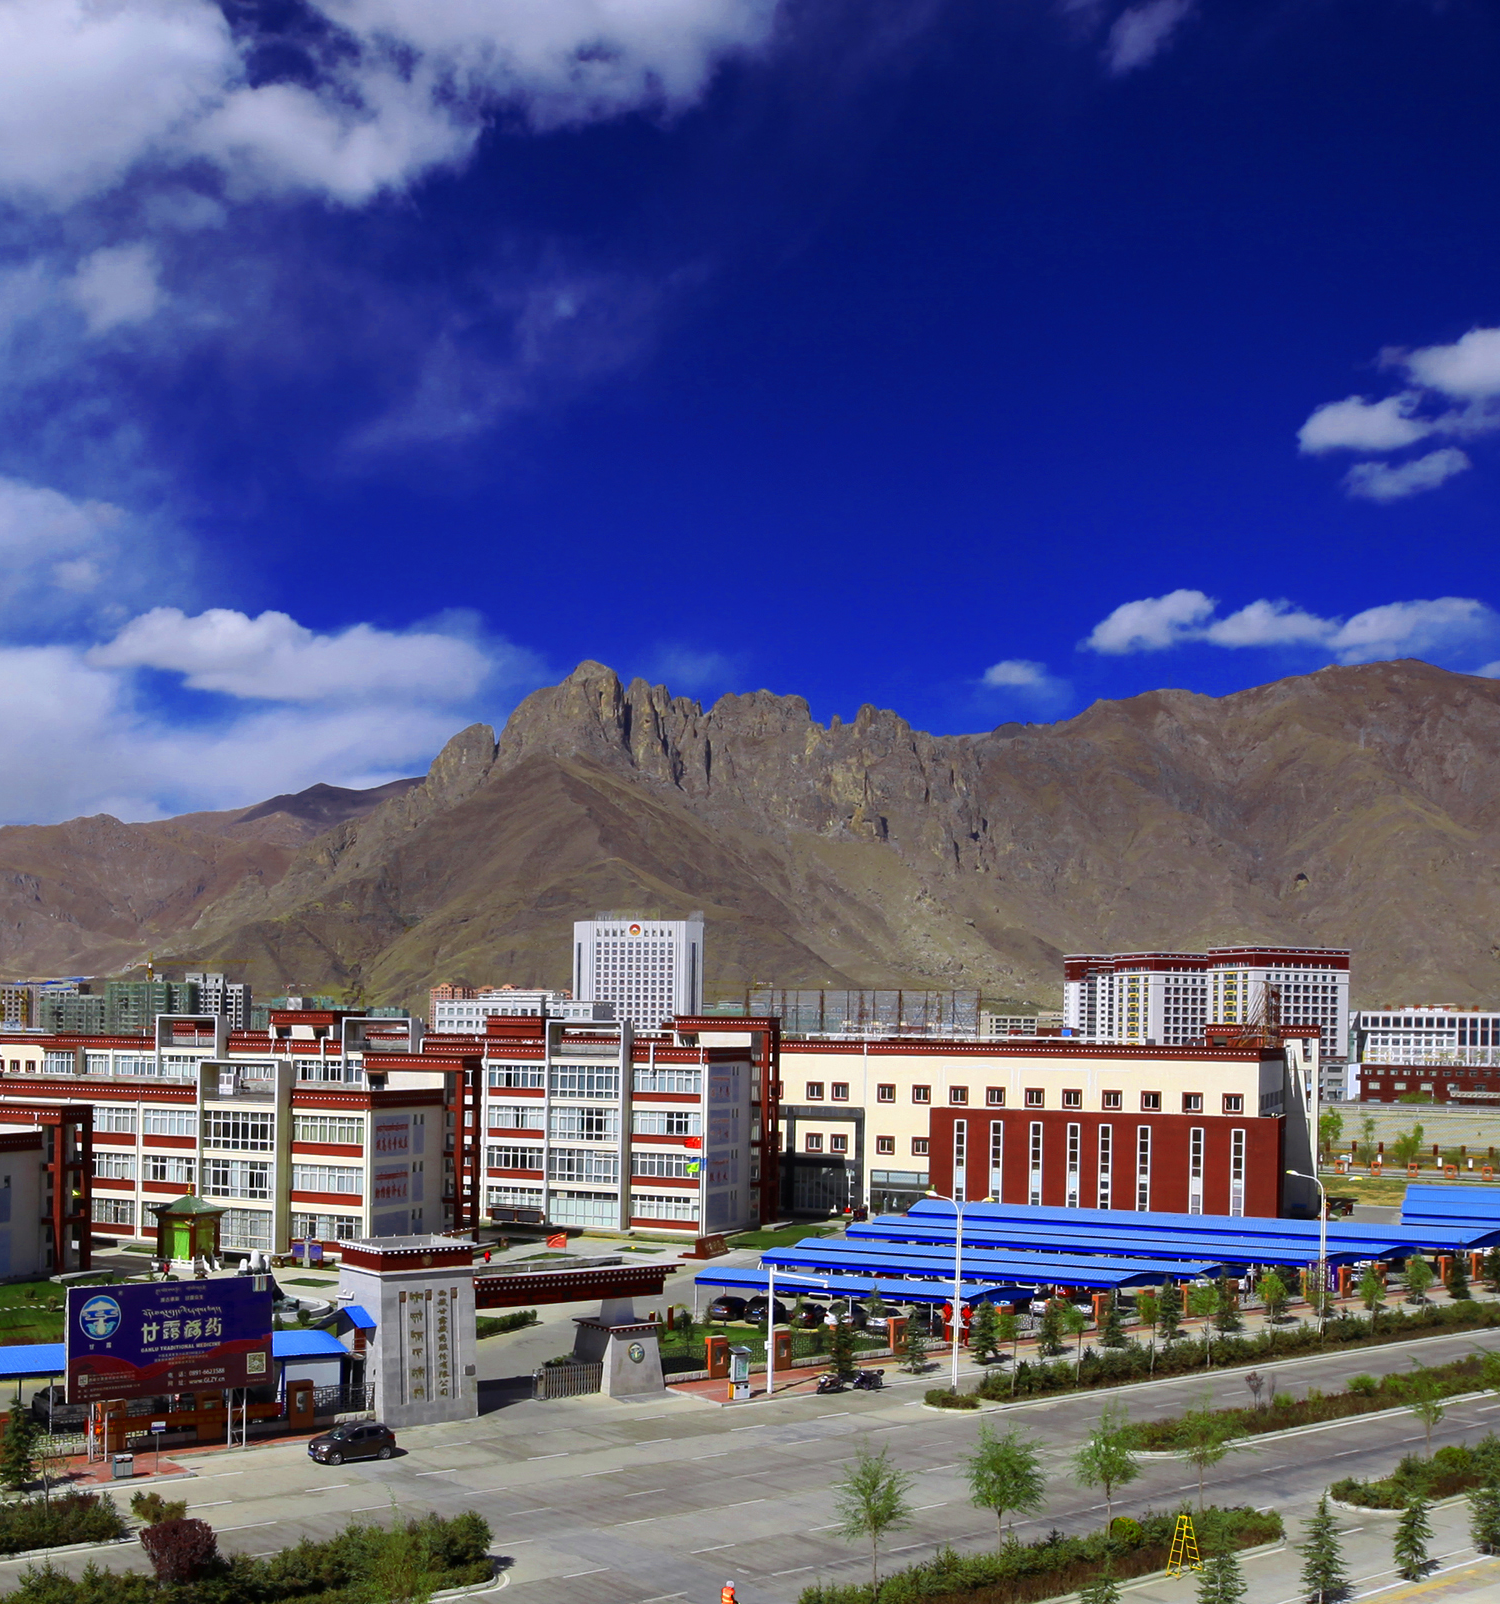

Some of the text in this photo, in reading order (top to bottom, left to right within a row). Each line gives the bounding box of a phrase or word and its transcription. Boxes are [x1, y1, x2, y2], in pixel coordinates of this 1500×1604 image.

[141, 1317, 223, 1344] 甘露藏药
[160, 1343, 195, 1351] TRADITIONAL
[195, 1341, 222, 1349] MEDICINE
